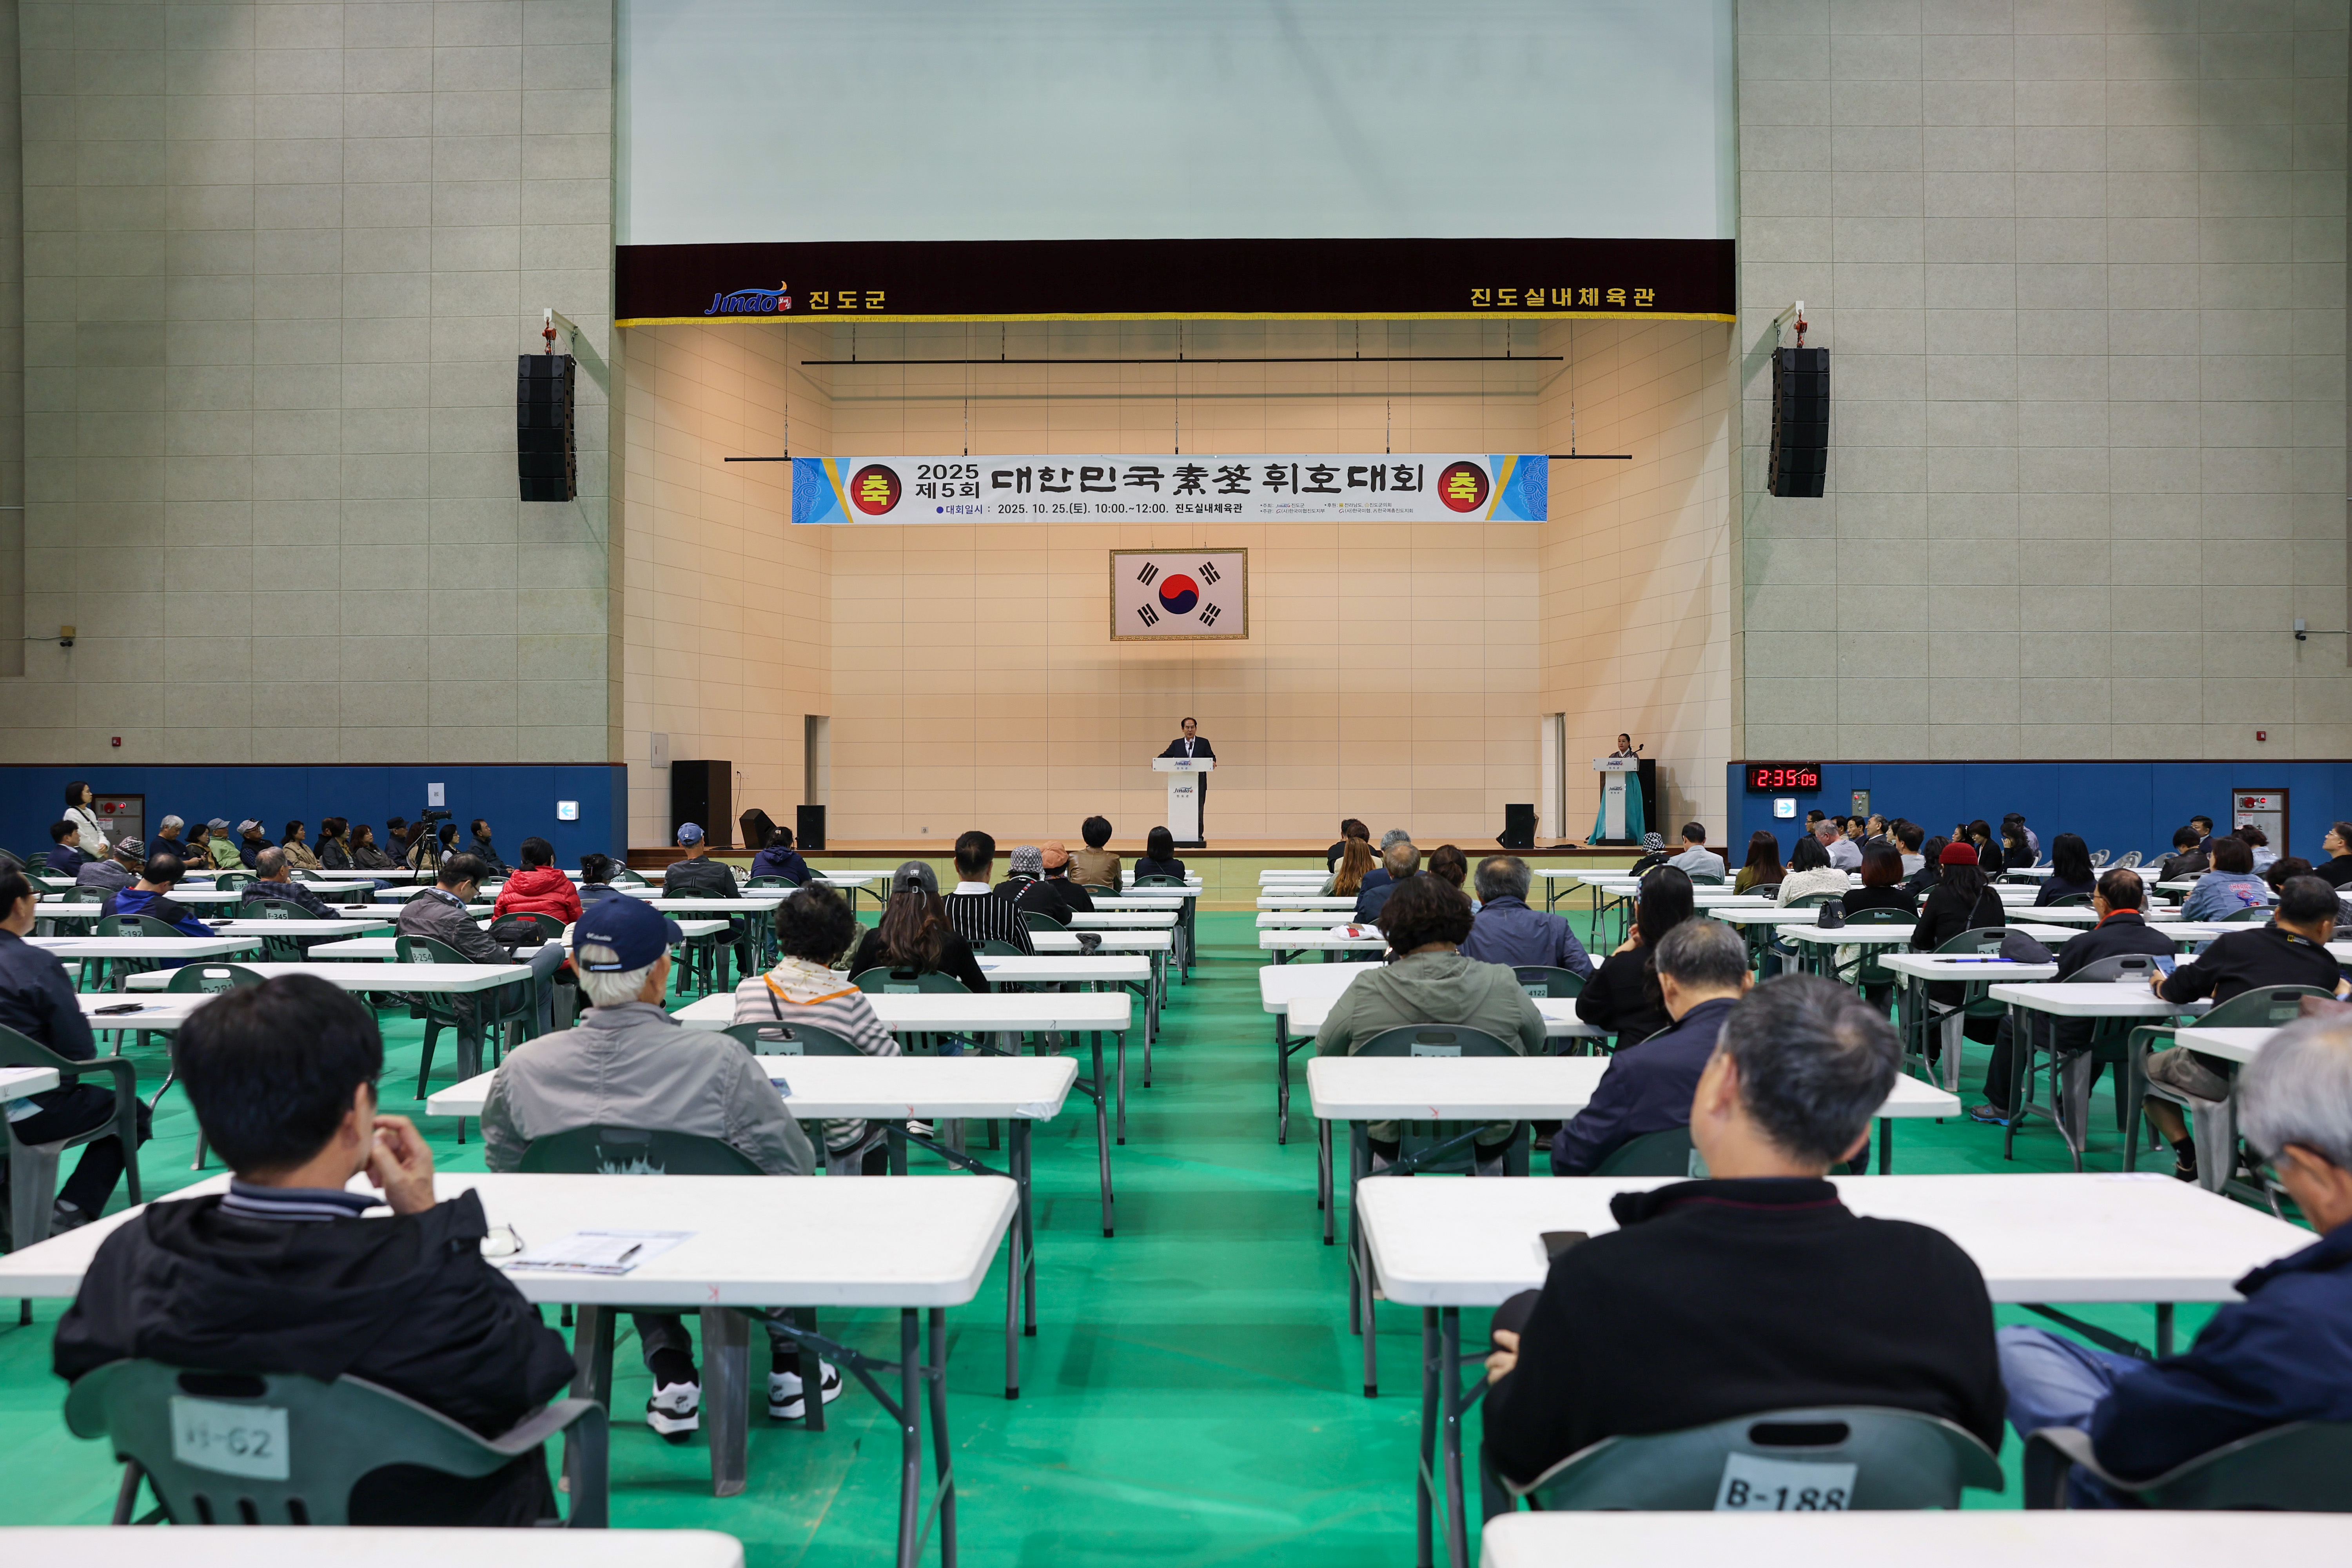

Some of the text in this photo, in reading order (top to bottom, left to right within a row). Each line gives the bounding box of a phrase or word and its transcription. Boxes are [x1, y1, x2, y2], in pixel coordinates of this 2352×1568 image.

[704, 293, 777, 314] Jindo
[809, 290, 885, 310] 진도군
[1471, 288, 1655, 307] 진도실내체육관
[917, 464, 978, 479] 2025
[860, 475, 890, 505] 축
[915, 482, 979, 499] 제5회
[1448, 472, 1477, 503] 축
[946, 505, 983, 514] 대회일시
[998, 504, 1028, 514] 2025.
[1033, 504, 1048, 513] 10.
[1175, 503, 1242, 514] 진도실내체육관
[1727, 1479, 1845, 1510] B-188
